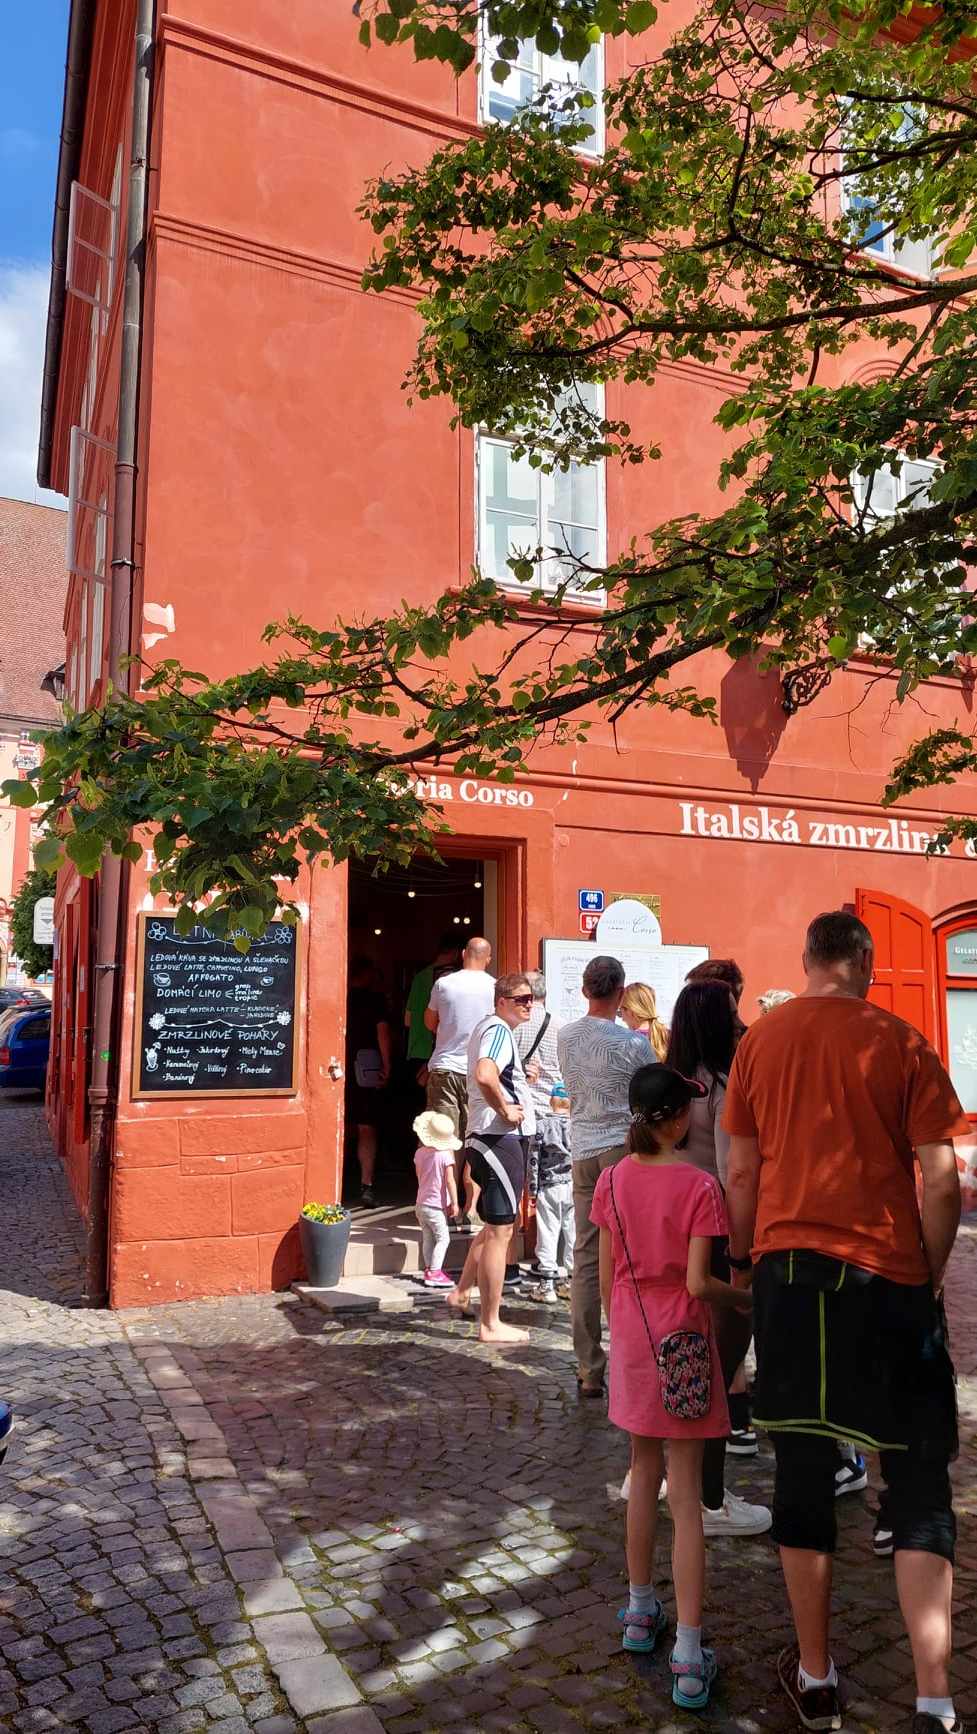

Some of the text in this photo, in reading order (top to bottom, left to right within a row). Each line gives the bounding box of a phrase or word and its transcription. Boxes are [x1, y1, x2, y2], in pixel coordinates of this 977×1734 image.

[459, 780, 534, 807] Corso
[679, 802, 800, 844] Italská
[245, 955, 250, 963] A
[187, 973, 234, 983] AFFOGATO
[156, 984, 222, 998] DOMÁCÍ LIMO
[158, 1028, 279, 1040] ZMRZLINOVÉ POHÁRY
